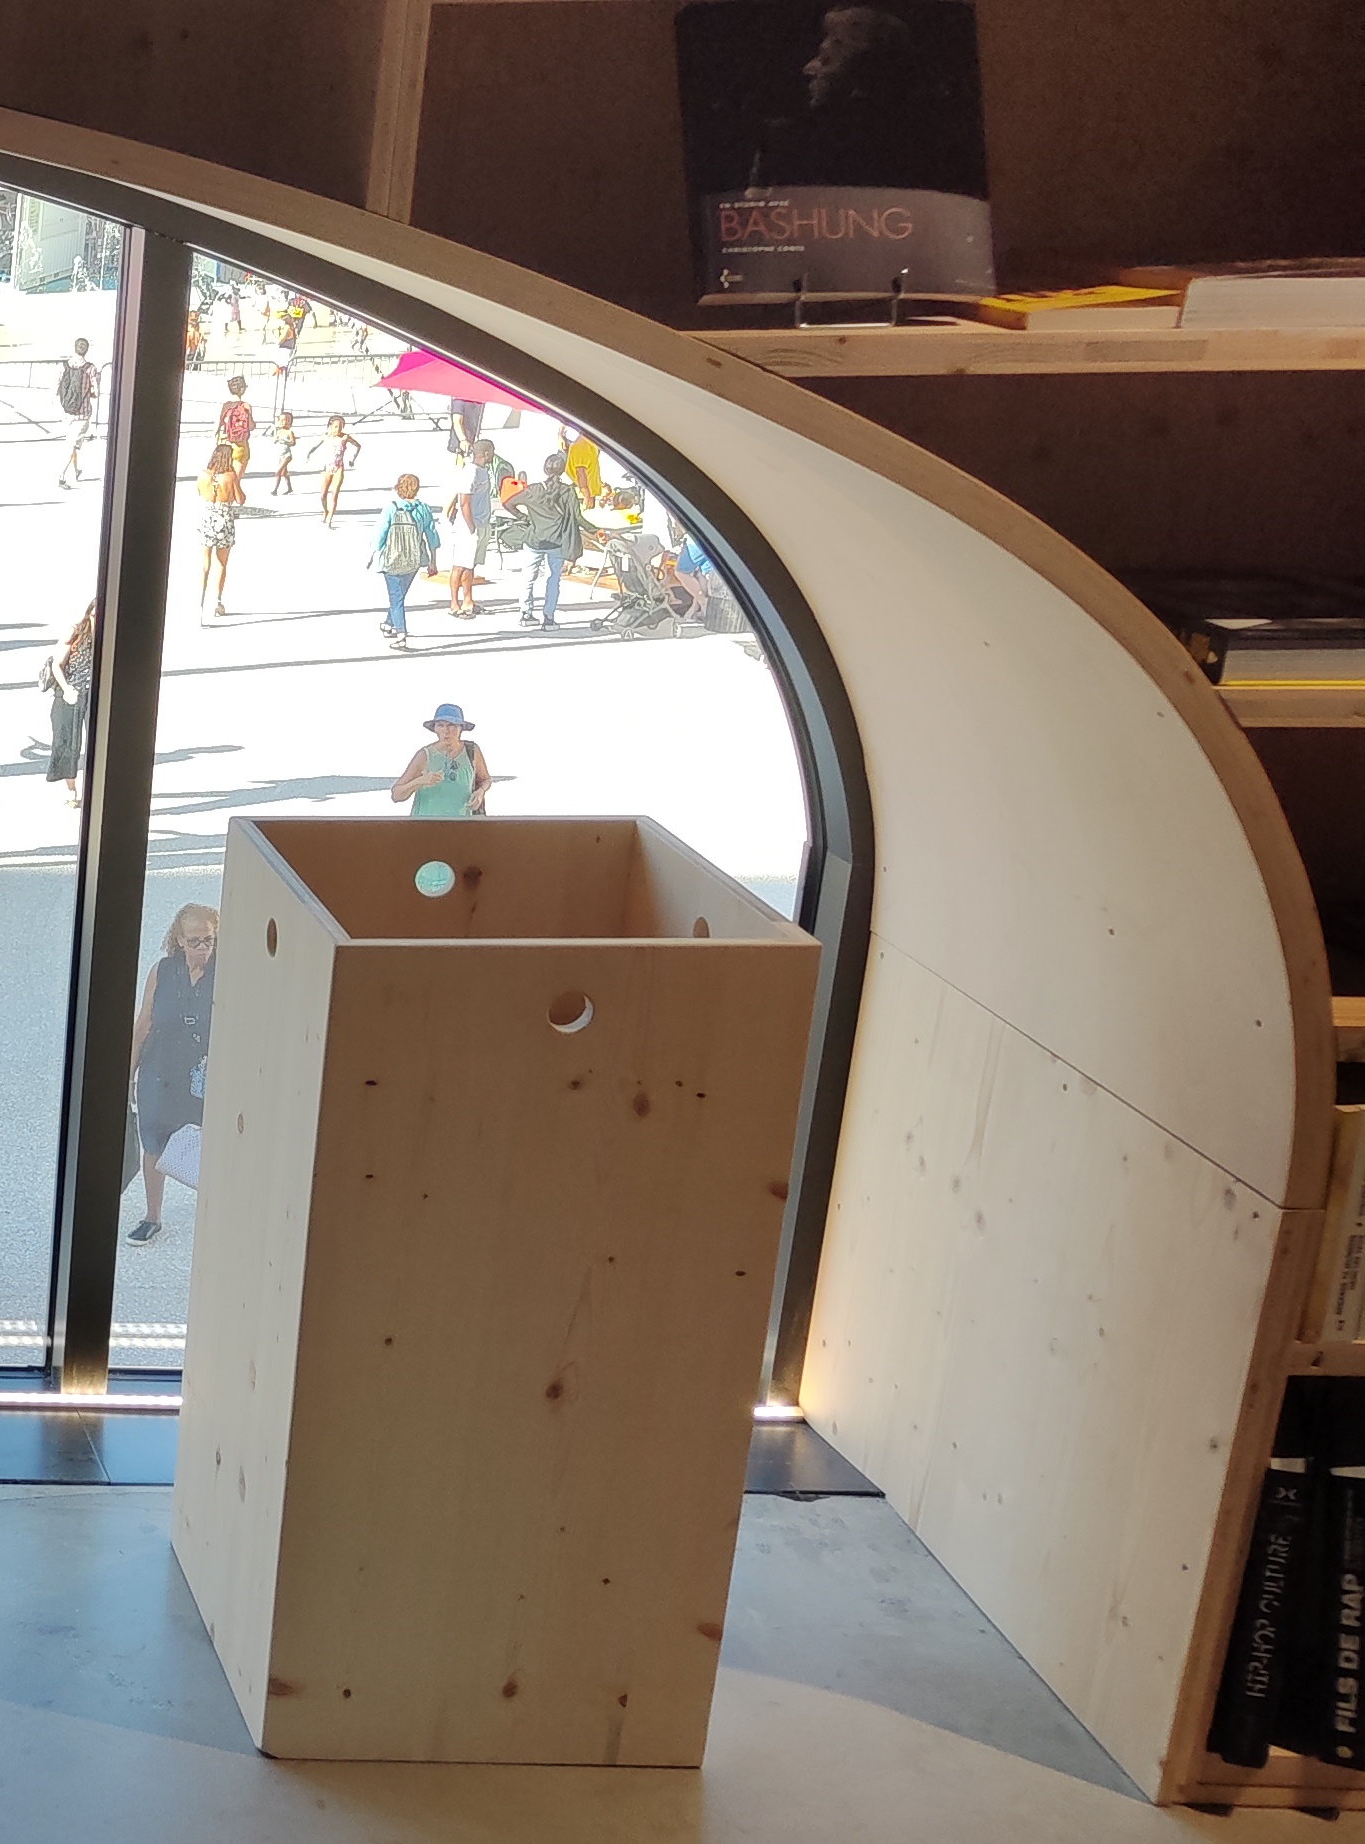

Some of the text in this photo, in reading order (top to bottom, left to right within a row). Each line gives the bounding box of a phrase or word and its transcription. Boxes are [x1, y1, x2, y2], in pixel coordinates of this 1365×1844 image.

[720, 206, 914, 242] BASHUNG
[1245, 1533, 1292, 1699] HIP-HOP CULTURE
[1340, 1573, 1364, 1628] RAP
[1338, 1635, 1360, 1670] DE
[1335, 1676, 1359, 1733] FILS
